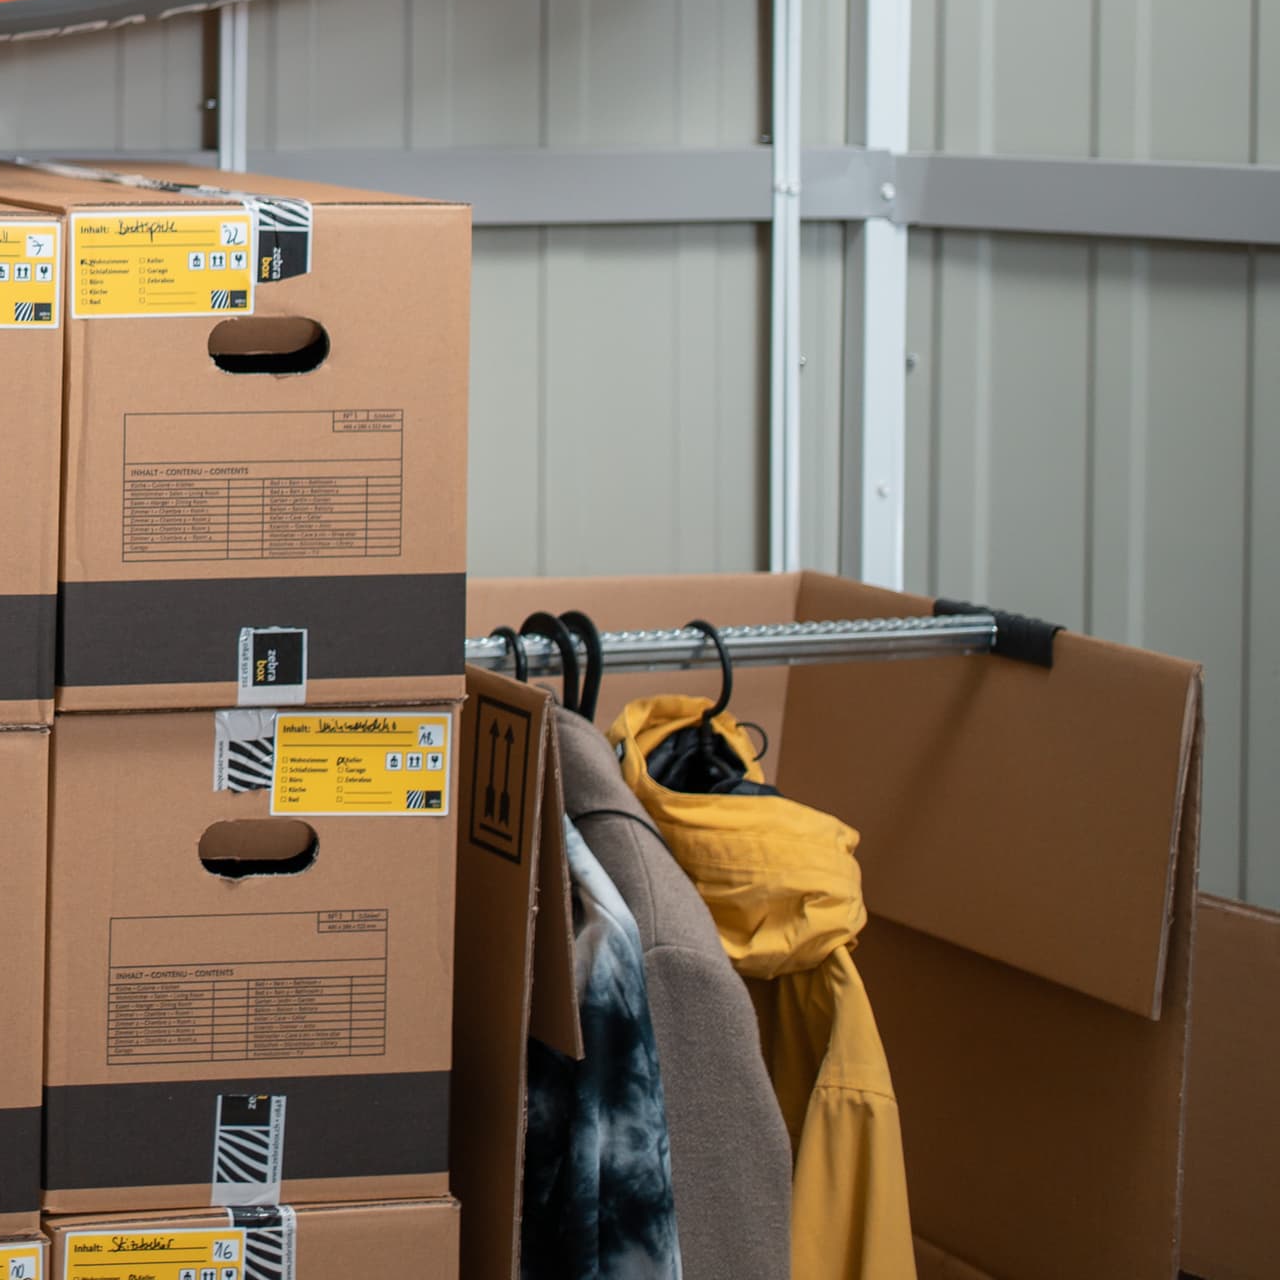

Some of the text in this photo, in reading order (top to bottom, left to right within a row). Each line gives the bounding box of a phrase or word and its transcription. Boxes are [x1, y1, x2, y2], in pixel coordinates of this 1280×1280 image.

[80, 225, 109, 234] Inhalt:
[261, 257, 272, 279] box
[272, 247, 283, 279] zebra
[255, 659, 267, 681] box
[267, 649, 279, 682] zebra
[283, 725, 310, 733] Inhalt:
[74, 1244, 103, 1252] Inhalt:
